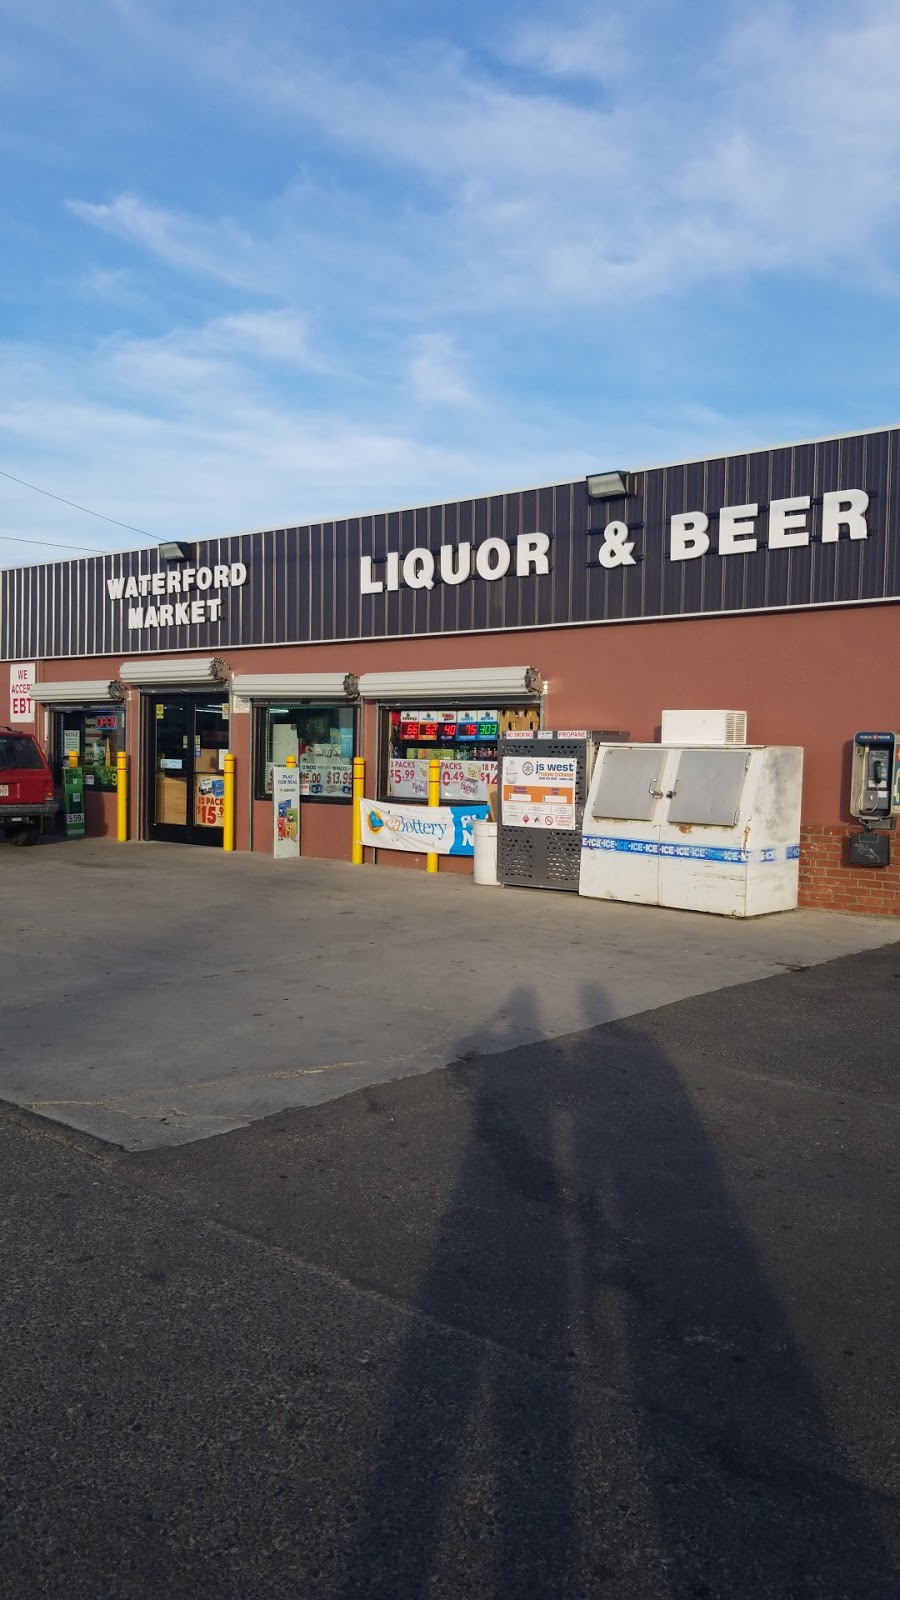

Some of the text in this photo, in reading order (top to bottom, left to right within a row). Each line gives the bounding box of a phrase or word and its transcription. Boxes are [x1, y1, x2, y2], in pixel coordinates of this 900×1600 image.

[360, 488, 870, 594] LIQUOR & BEER
[107, 563, 247, 599] WATERFORD
[128, 598, 221, 629] MARKET
[17, 669, 28, 680] WE
[12, 698, 32, 714] EBT
[97, 717, 116, 728] OPEN
[425, 724, 437, 735] 52
[444, 725, 456, 735] 40
[466, 724, 477, 735] 75
[479, 724, 497, 735] 303
[440, 762, 462, 770] PACKS
[535, 761, 574, 774] js west
[390, 769, 415, 784] $5.99
[197, 805, 224, 824] $15.9
